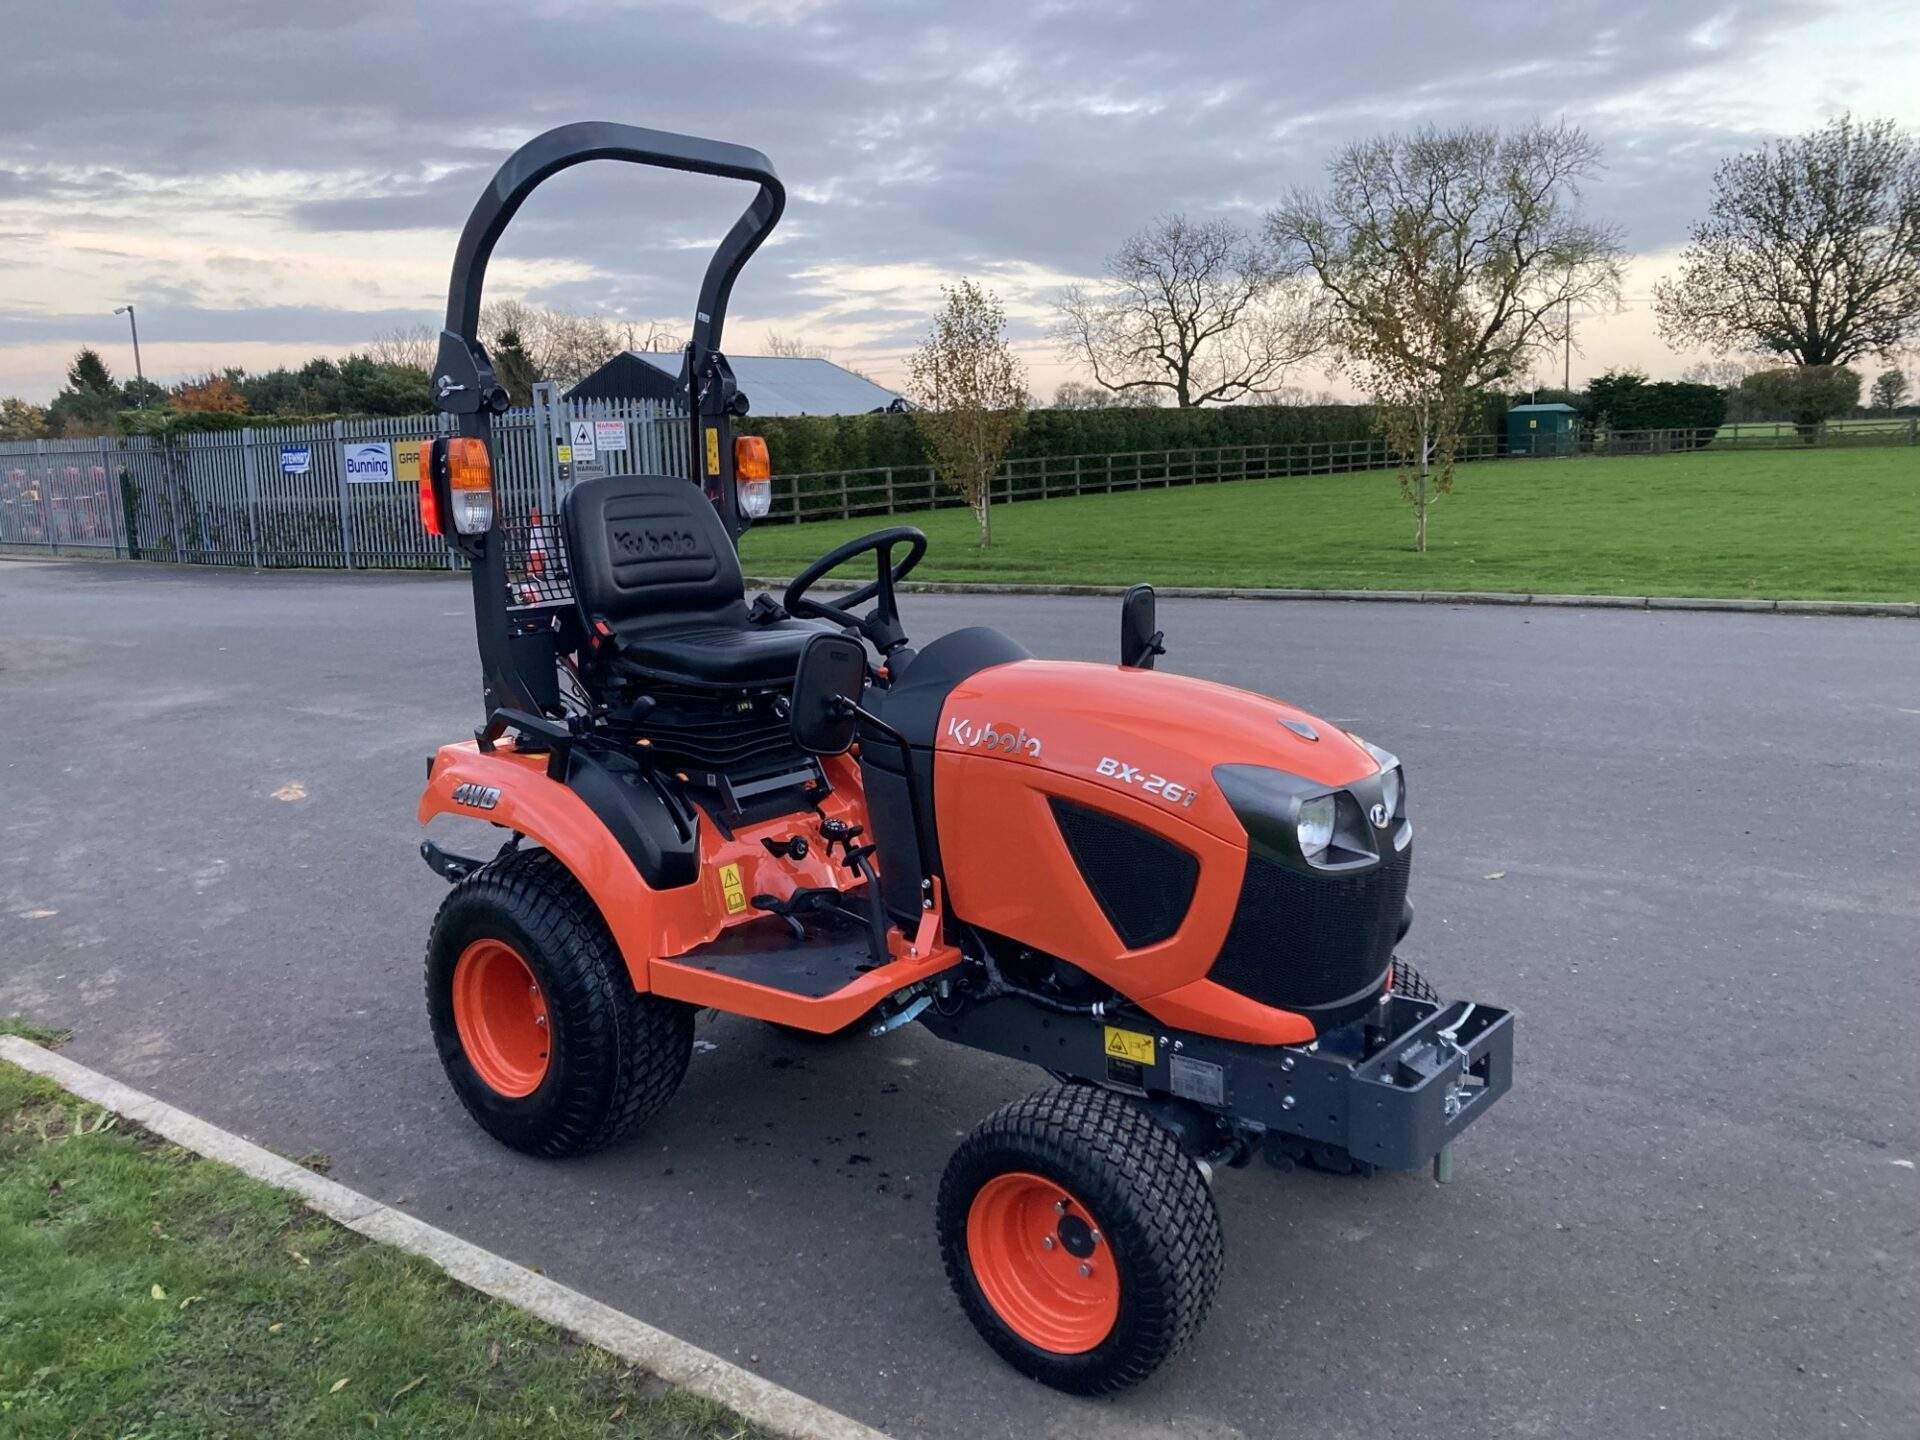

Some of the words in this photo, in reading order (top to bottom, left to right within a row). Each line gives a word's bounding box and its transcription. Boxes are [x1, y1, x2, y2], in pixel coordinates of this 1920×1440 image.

[347, 457, 388, 476] Bunning
[576, 464, 604, 472] WARNING
[612, 529, 697, 556] Kubota
[948, 717, 1042, 757] Kubota
[452, 782, 501, 810] 4WD
